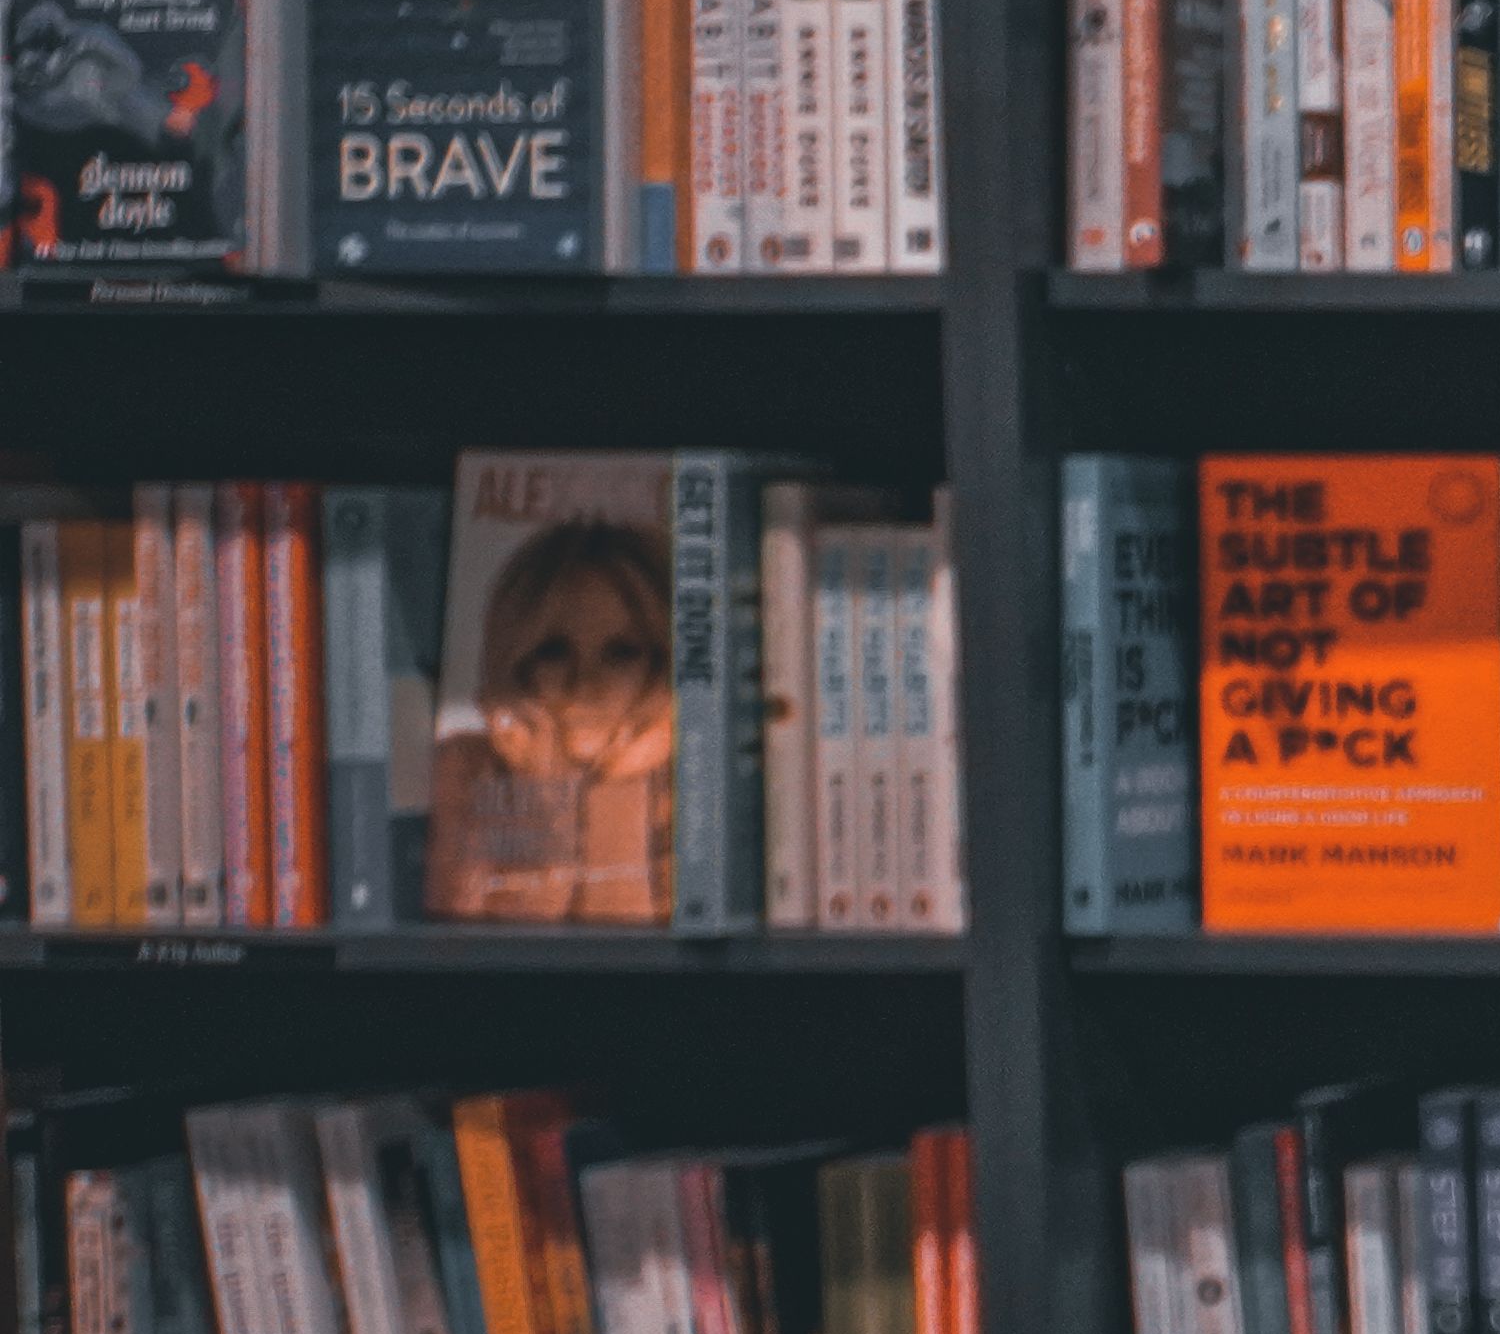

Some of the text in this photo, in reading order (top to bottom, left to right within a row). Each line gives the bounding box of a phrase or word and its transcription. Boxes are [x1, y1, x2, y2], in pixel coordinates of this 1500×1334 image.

[386, 81, 523, 124] Seconds
[79, 154, 191, 199] glennon
[339, 133, 572, 200] BRAVE
[99, 193, 175, 229] doyle
[1217, 482, 1326, 522] THE
[1217, 531, 1431, 573] SUBTLE
[1217, 581, 1427, 619] ART OF
[1218, 629, 1334, 668] NOT
[1221, 681, 1418, 718] GIVING
[1223, 731, 1256, 765] A
